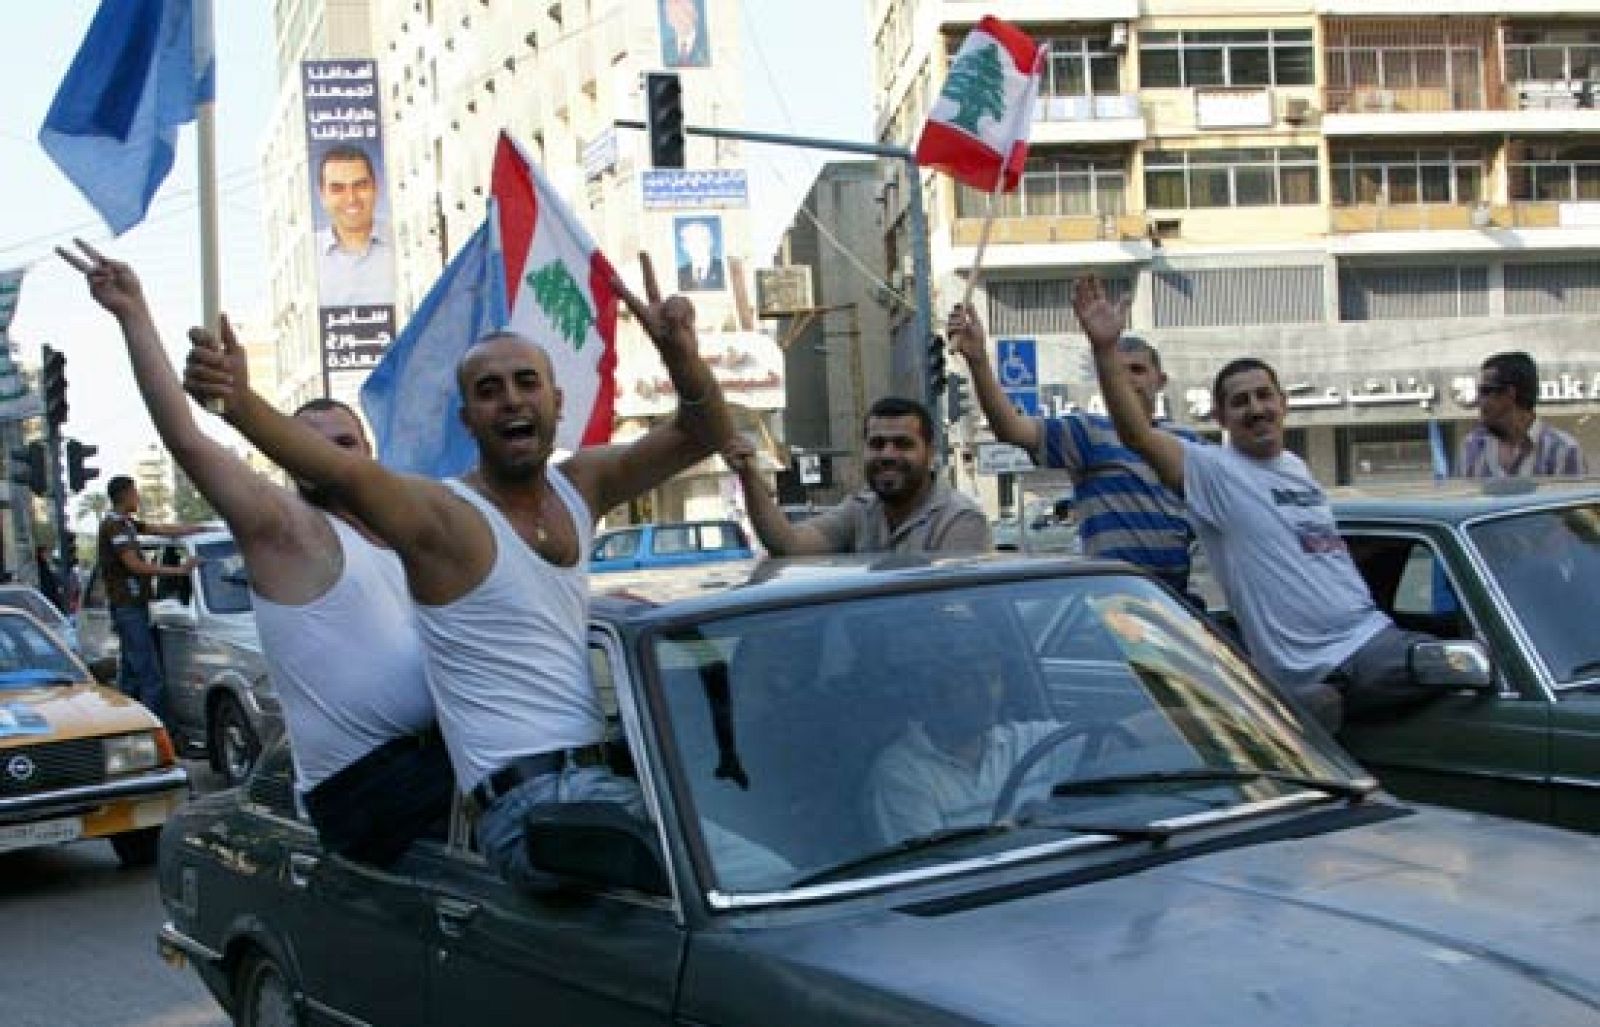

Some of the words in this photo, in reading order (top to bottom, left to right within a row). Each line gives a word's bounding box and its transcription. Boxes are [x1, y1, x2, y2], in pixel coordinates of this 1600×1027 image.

[310, 107, 375, 123] طرابلس
[326, 308, 388, 329] سامر
[326, 332, 391, 350] جورج
[1541, 374, 1584, 399] nk
